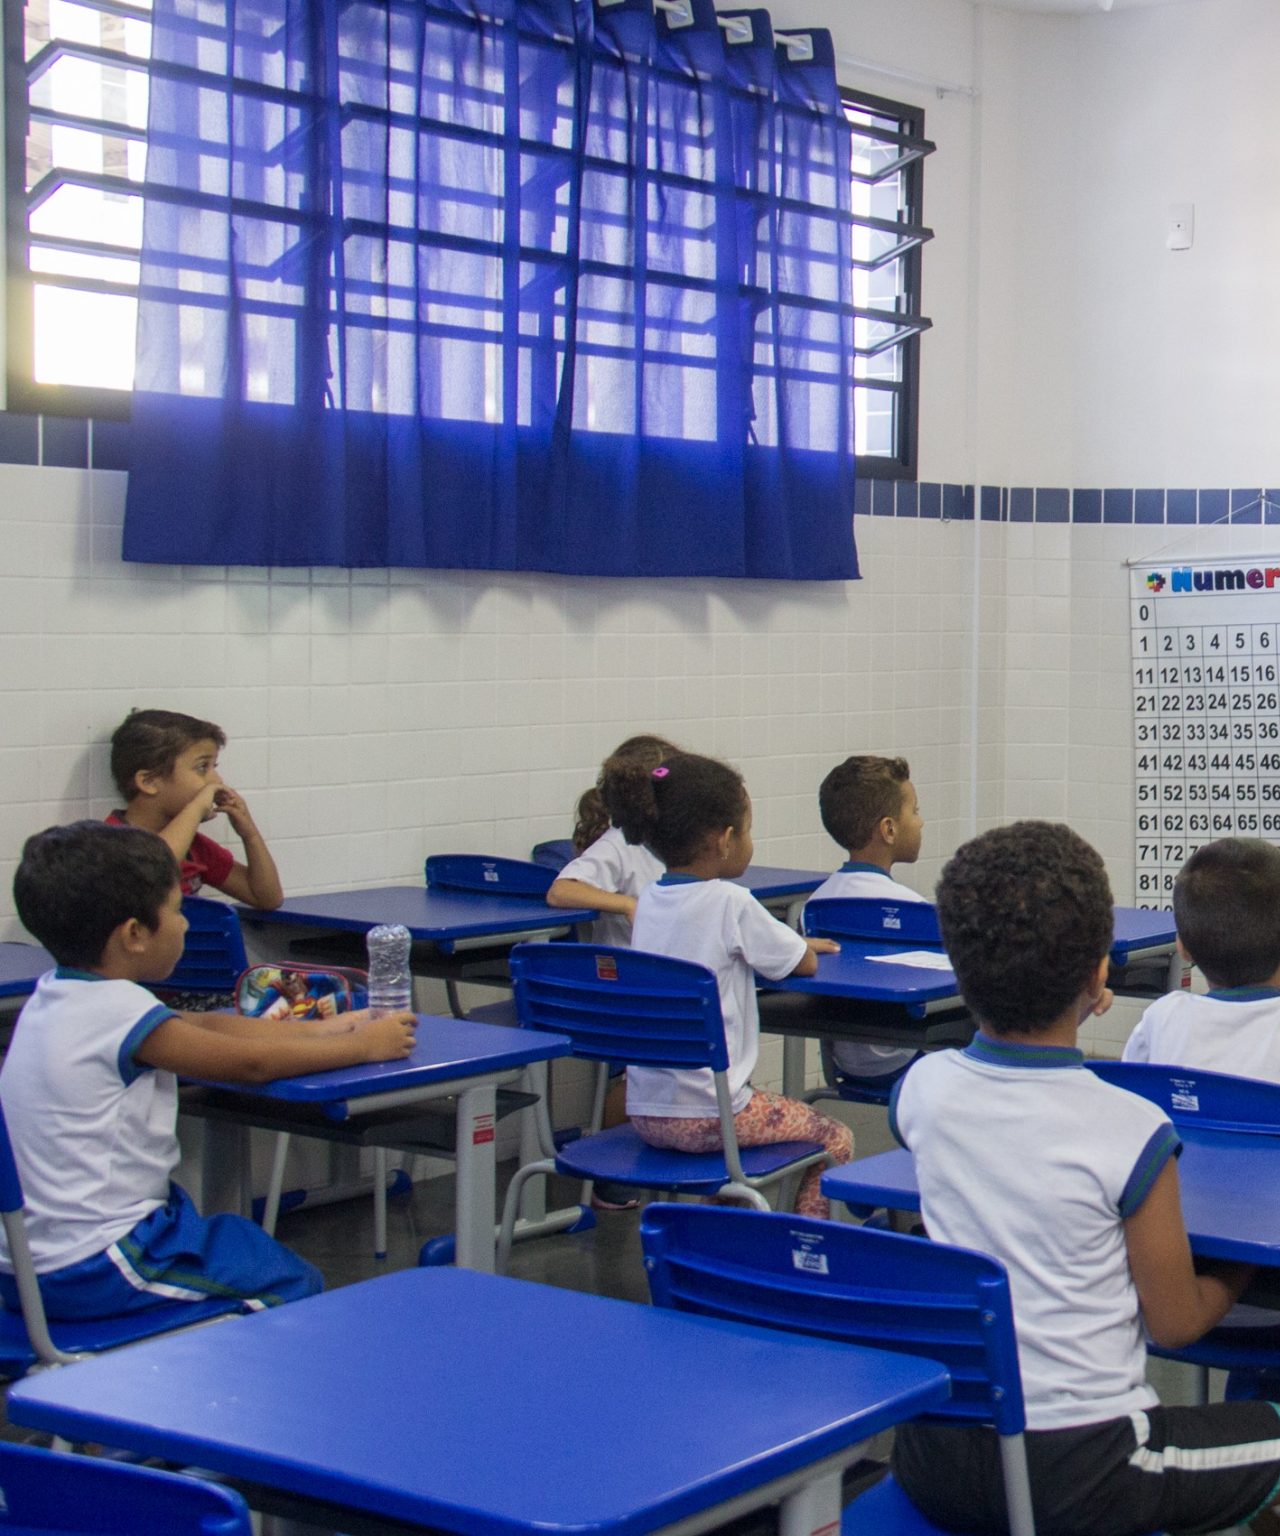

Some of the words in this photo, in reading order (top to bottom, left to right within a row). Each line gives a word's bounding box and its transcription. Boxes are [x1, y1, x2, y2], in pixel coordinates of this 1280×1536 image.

[1140, 605, 1149, 620] 0
[1141, 637, 1148, 651] 1
[1164, 636, 1173, 651] 2
[1186, 635, 1195, 650] 3
[1210, 634, 1220, 649] 4
[1235, 633, 1245, 648] 5
[1260, 632, 1269, 648] 6
[1136, 669, 1153, 684] 11
[1160, 668, 1179, 683] 12
[1184, 667, 1202, 683] 13
[1206, 667, 1225, 682] 14
[1230, 666, 1250, 682] 15
[1256, 665, 1275, 681] 16
[1137, 696, 1155, 711] 21
[1162, 696, 1180, 711] 22
[1186, 695, 1204, 710] 23
[1208, 694, 1227, 709] 24
[1233, 694, 1252, 710] 25
[1257, 694, 1277, 709] 26
[1138, 725, 1157, 740] 31
[1162, 725, 1181, 740] 32
[1187, 724, 1206, 740] 33
[1209, 724, 1229, 740] 34
[1234, 724, 1253, 740] 35
[1258, 723, 1278, 739] 36
[1138, 755, 1157, 771] 41
[1163, 755, 1183, 770] 42
[1188, 755, 1206, 770] 43
[1210, 754, 1231, 770] 44
[1235, 754, 1255, 770] 45
[1260, 754, 1280, 770] 46
[1138, 785, 1157, 800] 51
[1163, 785, 1183, 800] 52
[1189, 785, 1207, 800] 53
[1211, 785, 1231, 800] 54
[1236, 785, 1256, 800] 55
[1138, 815, 1158, 831] 61
[1164, 815, 1184, 831] 62
[1189, 815, 1209, 831] 63
[1213, 815, 1233, 831] 64
[1238, 815, 1258, 831] 65
[1139, 845, 1158, 860] 71
[1164, 845, 1184, 861] 72
[1139, 874, 1158, 890] 81
